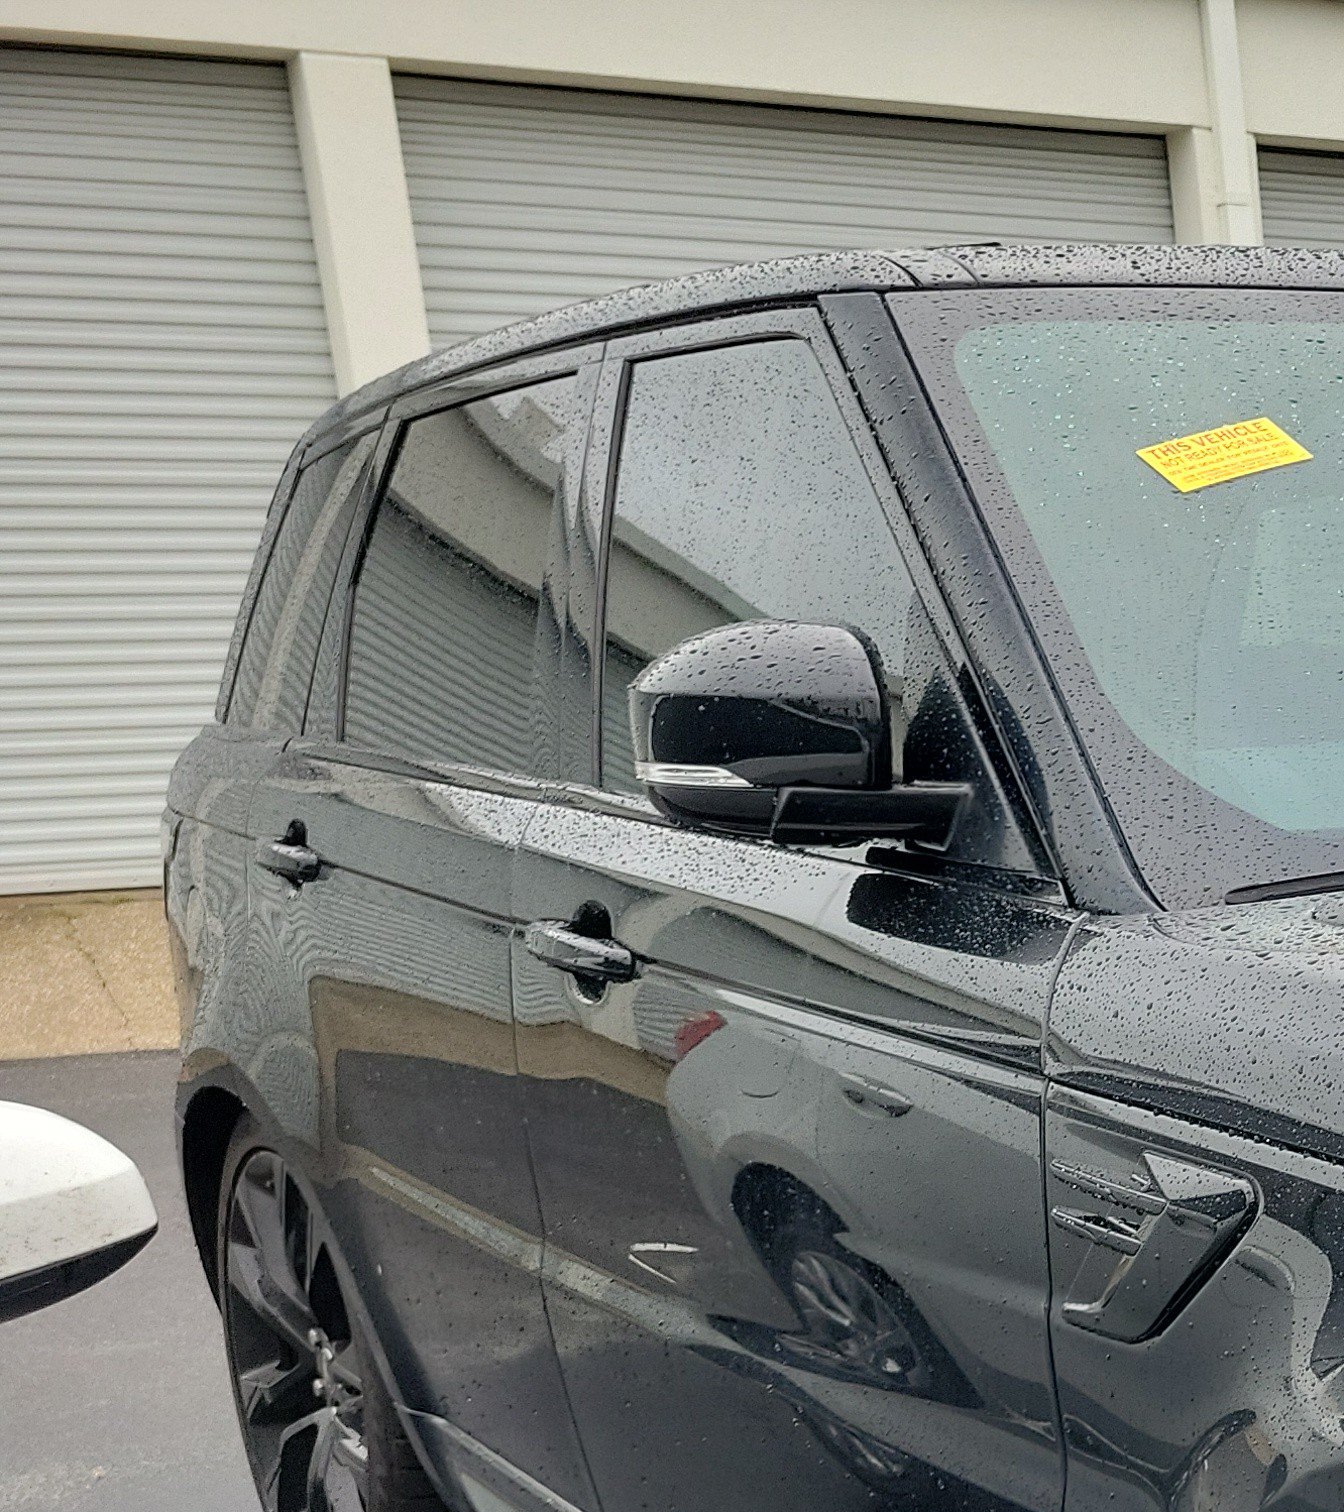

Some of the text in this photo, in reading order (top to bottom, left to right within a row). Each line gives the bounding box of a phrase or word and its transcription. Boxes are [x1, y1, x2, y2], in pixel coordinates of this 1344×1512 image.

[1145, 422, 1268, 461] THIS VEHICLE
[1160, 432, 1279, 469] NOT READY FOR SALE
